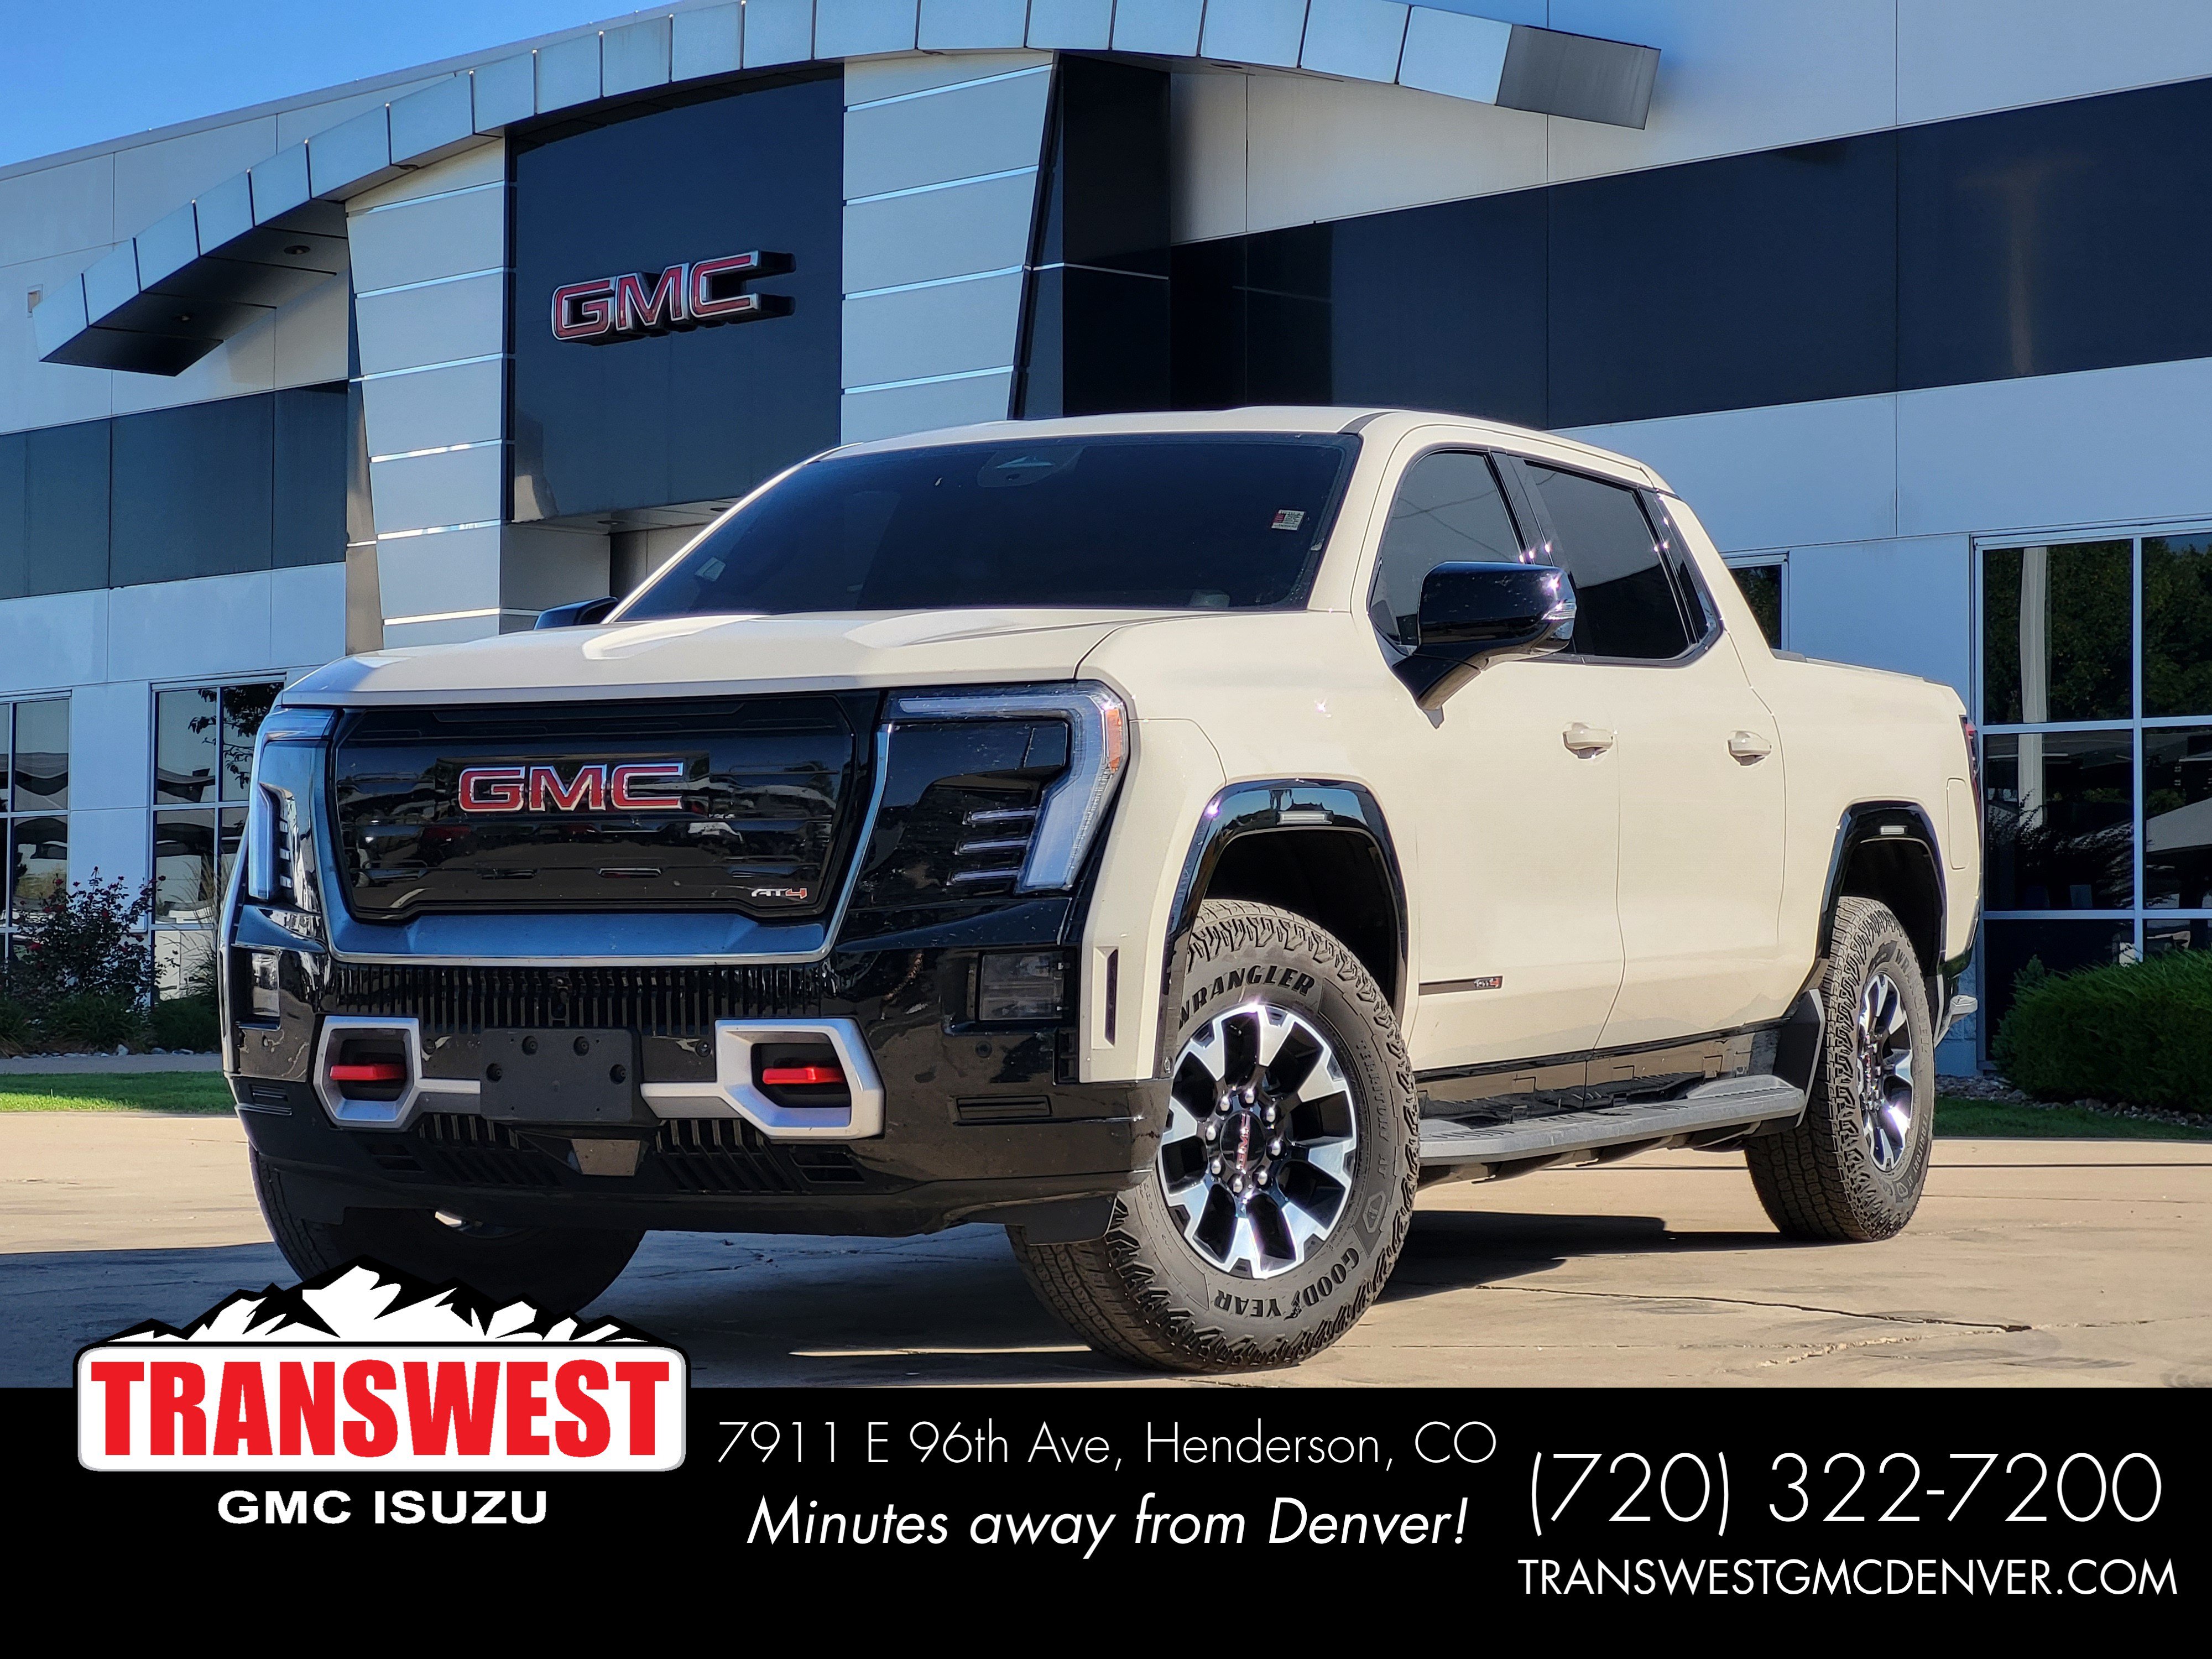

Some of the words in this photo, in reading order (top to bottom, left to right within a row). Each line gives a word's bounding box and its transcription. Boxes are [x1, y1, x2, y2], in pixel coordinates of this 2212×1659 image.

[551, 250, 760, 341] GMC
[458, 762, 684, 812] GMC
[751, 888, 807, 899] AT4
[1356, 1040, 1390, 1142] TERRITORY
